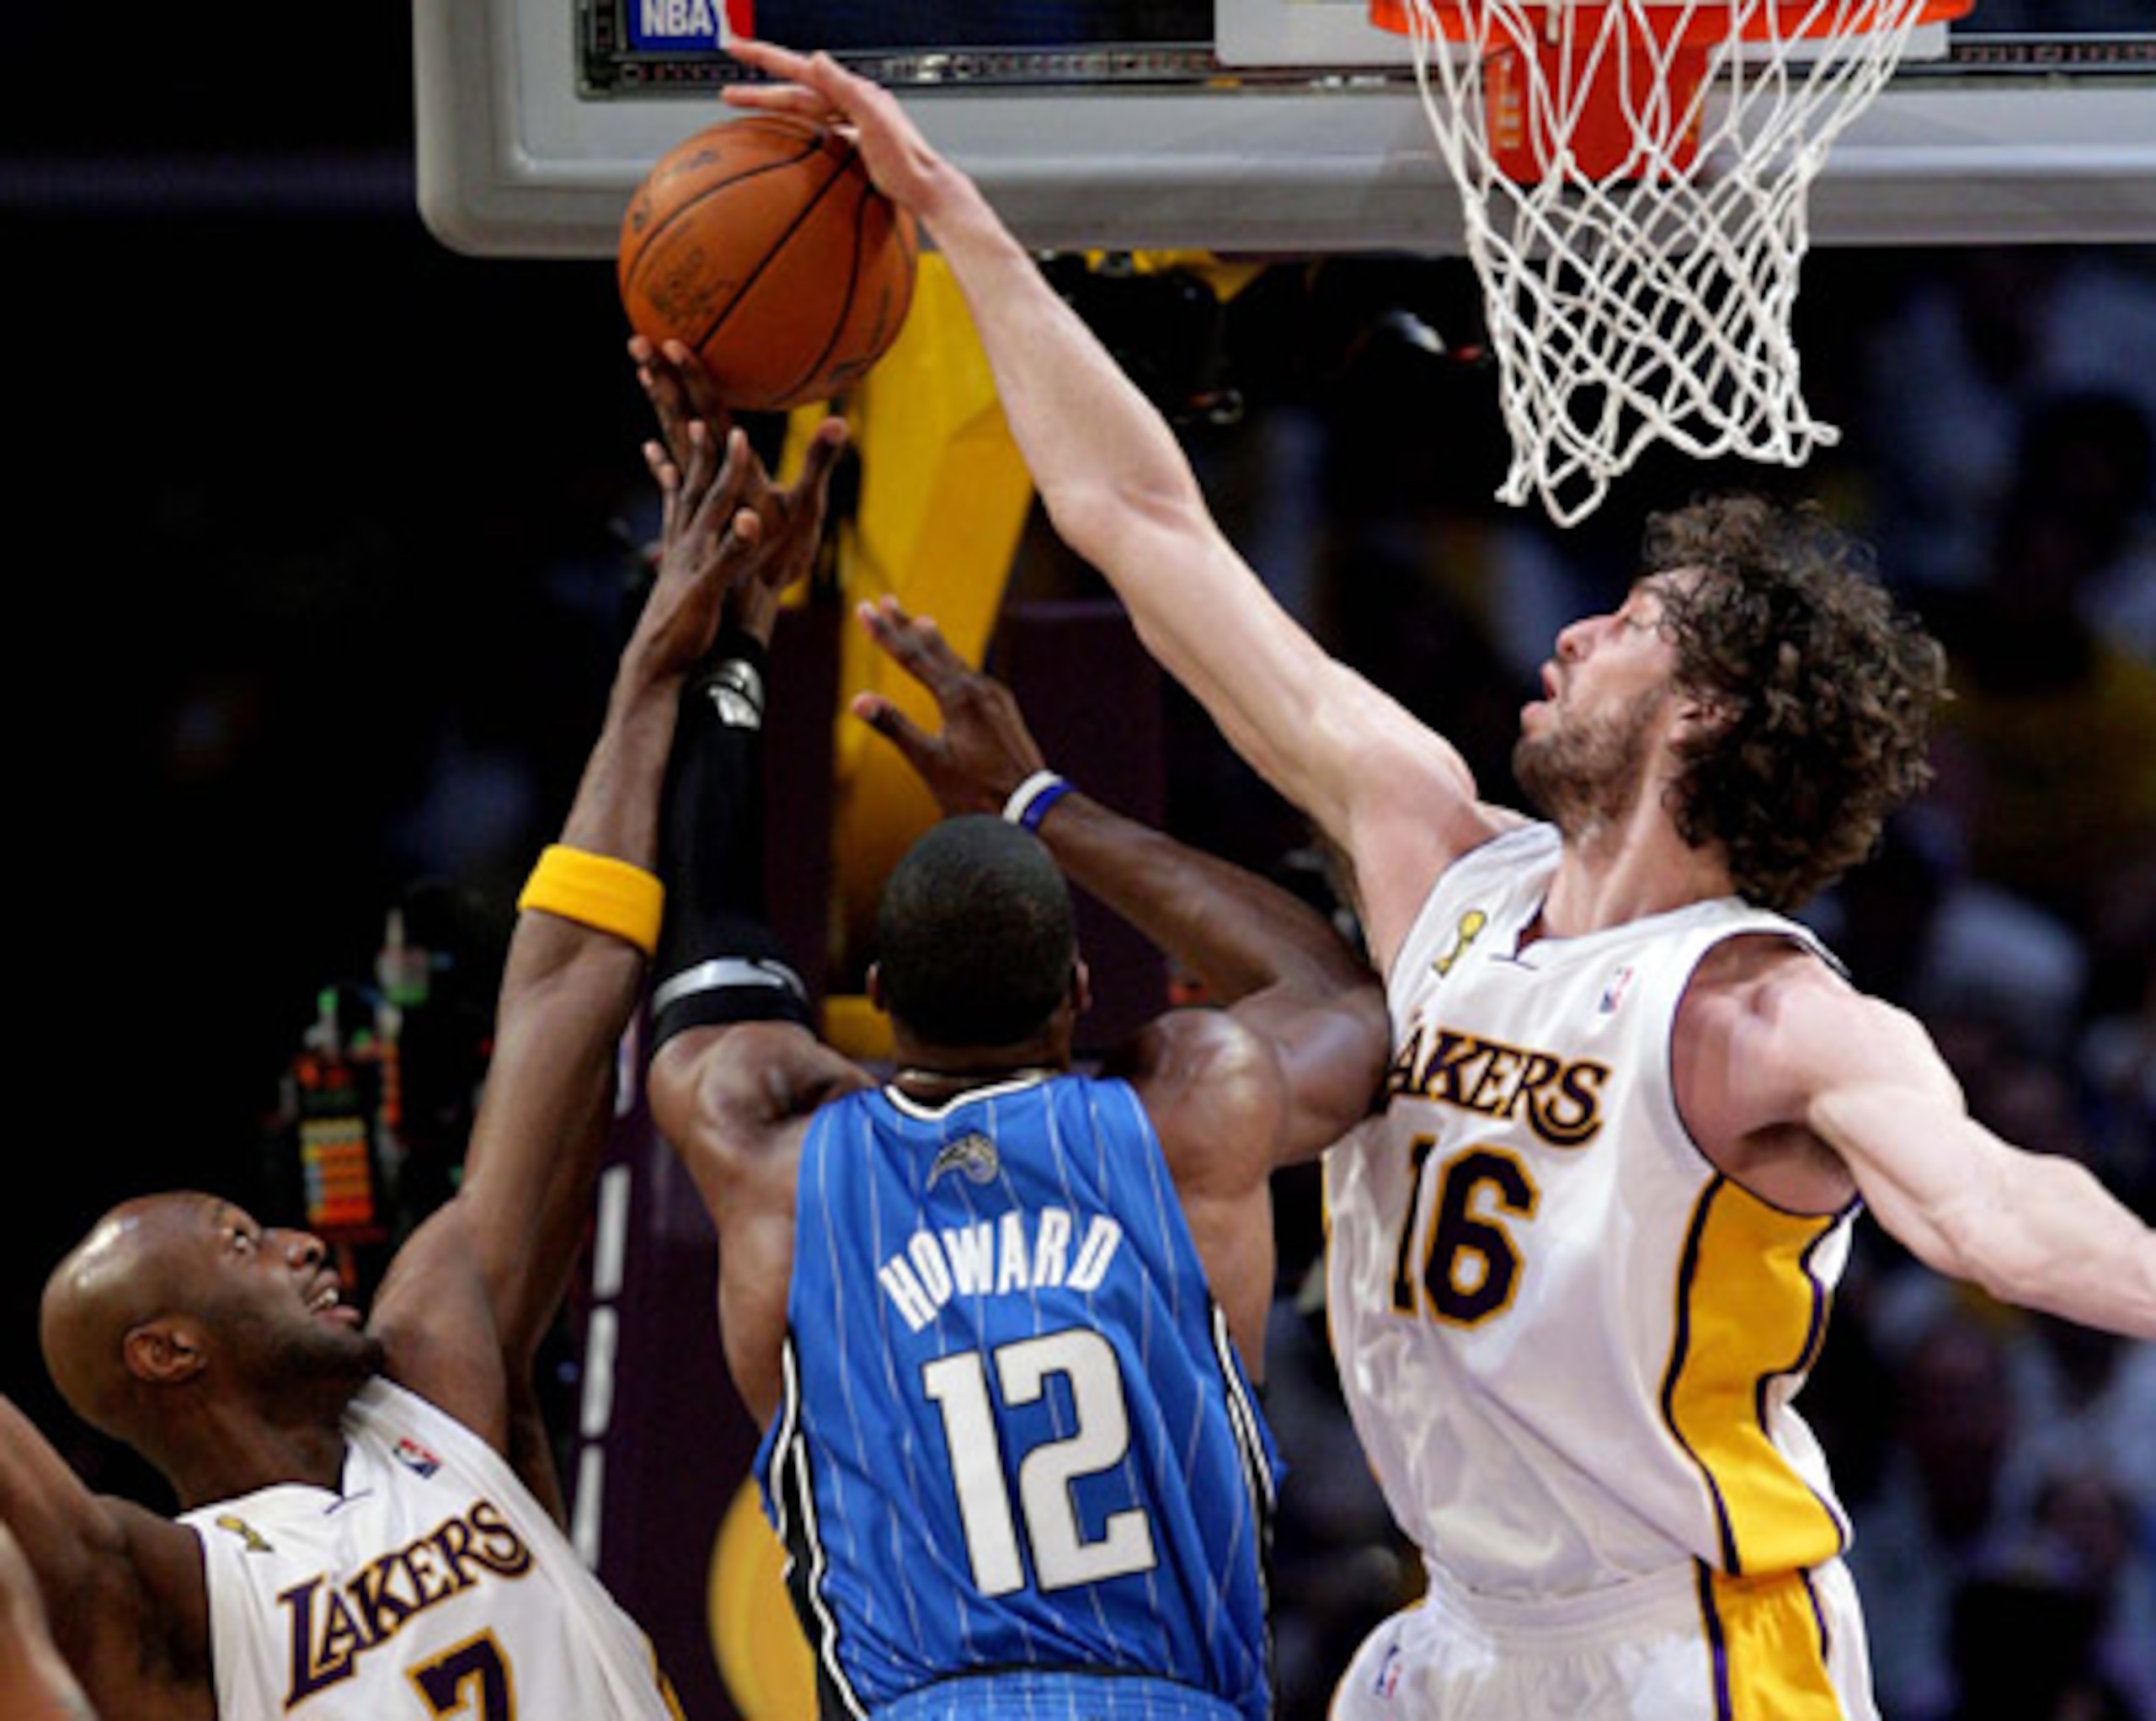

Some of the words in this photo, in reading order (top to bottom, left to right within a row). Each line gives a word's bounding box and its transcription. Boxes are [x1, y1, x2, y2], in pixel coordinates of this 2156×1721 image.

[639, 0, 714, 37] NBA
[1386, 1018, 1612, 1147] AKERS
[878, 1206, 1123, 1333] HOWARD
[1392, 1134, 1540, 1328] 16
[922, 1327, 1157, 1598] 12
[276, 1499, 536, 1714] LAKERS
